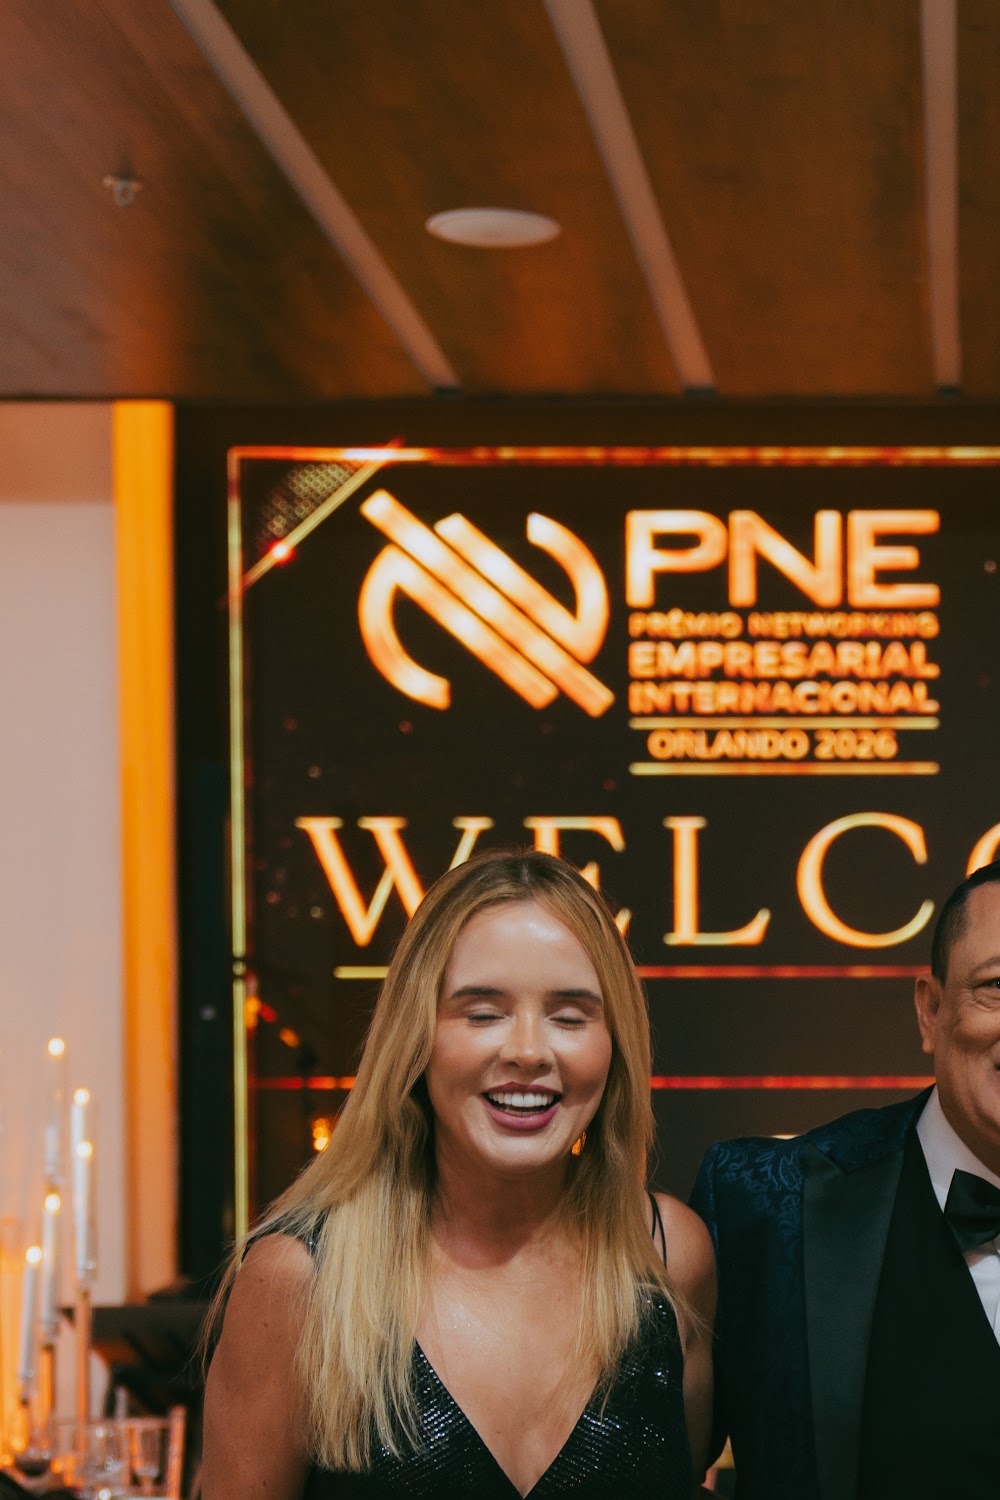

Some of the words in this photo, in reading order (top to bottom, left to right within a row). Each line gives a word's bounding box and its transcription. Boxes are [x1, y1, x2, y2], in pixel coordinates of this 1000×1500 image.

[626, 509, 940, 608] PNE
[628, 608, 743, 638] PRÊMIO
[748, 611, 940, 639] NETWORKING
[628, 640, 940, 679] EMPRESARIAL
[628, 680, 940, 714] INTERNACIONAL
[647, 728, 809, 760] ORLANDO
[814, 728, 898, 760] 2026
